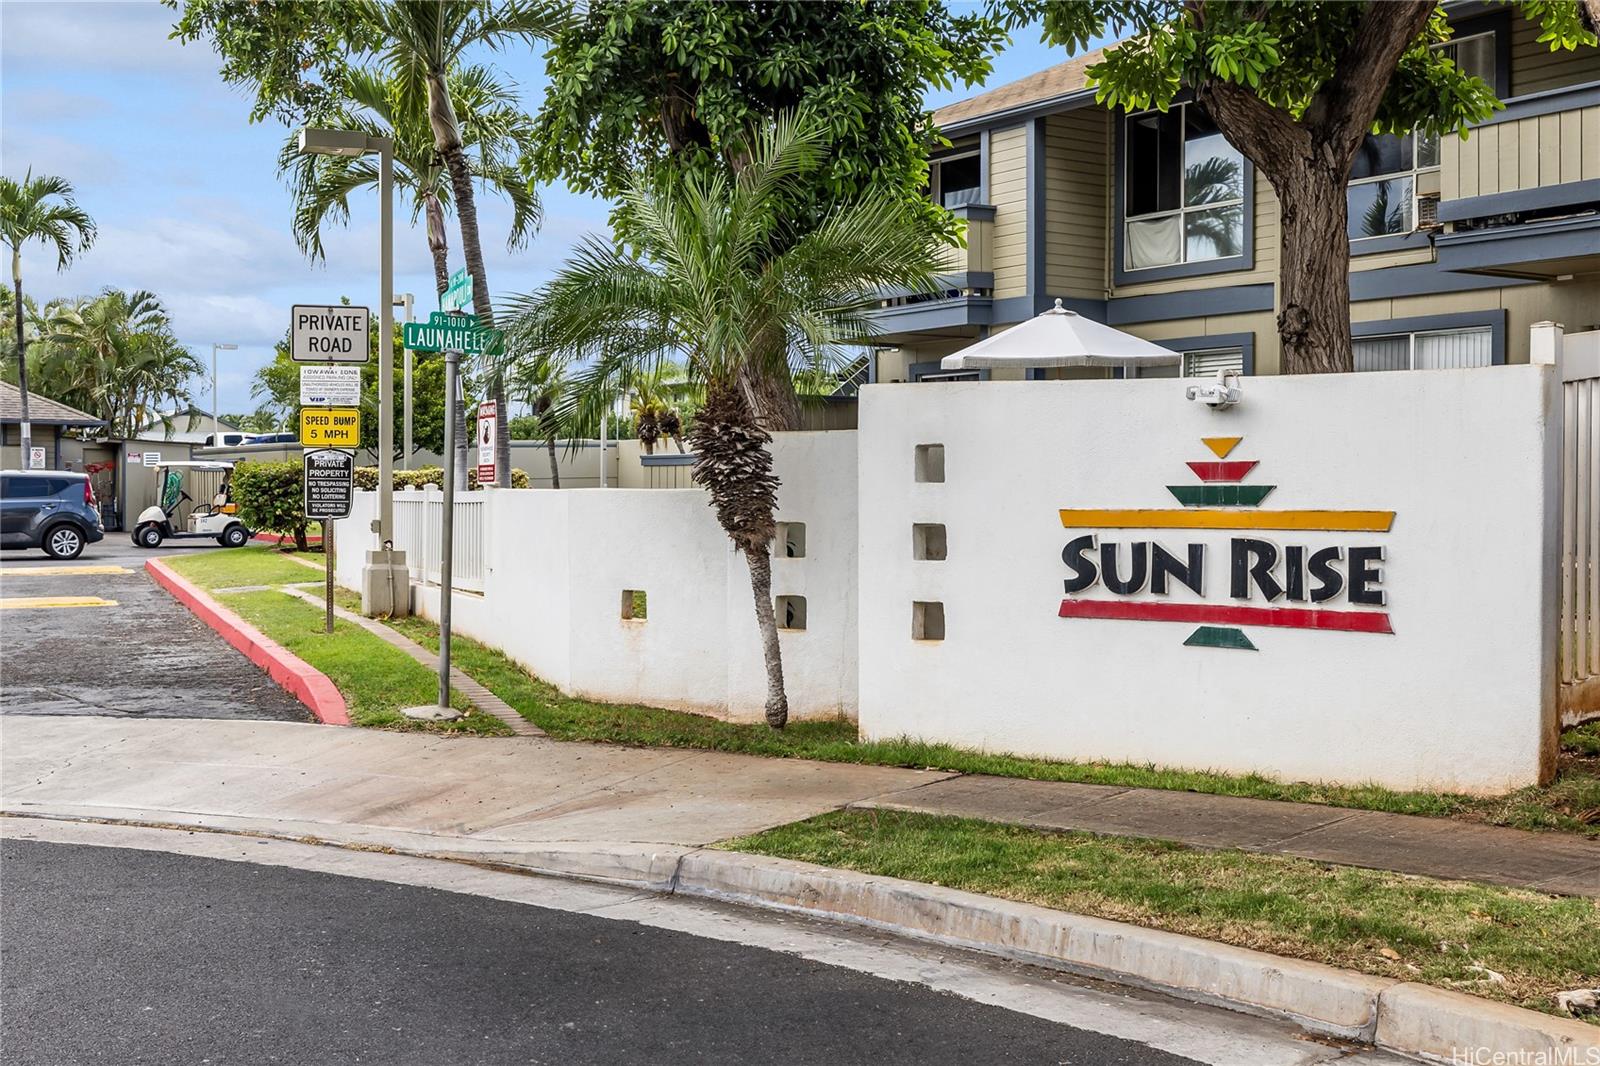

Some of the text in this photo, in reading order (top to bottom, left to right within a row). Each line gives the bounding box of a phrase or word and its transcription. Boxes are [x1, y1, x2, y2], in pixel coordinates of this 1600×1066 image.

[299, 315, 362, 331] PRIVATE
[434, 316, 466, 328] 91-1010
[309, 337, 352, 353] ROAD
[305, 416, 357, 426] SPEED BUMP
[310, 430, 349, 439] 5 MPH
[309, 469, 349, 477] PROPERTY
[1062, 534, 1387, 606] SUN RISE
